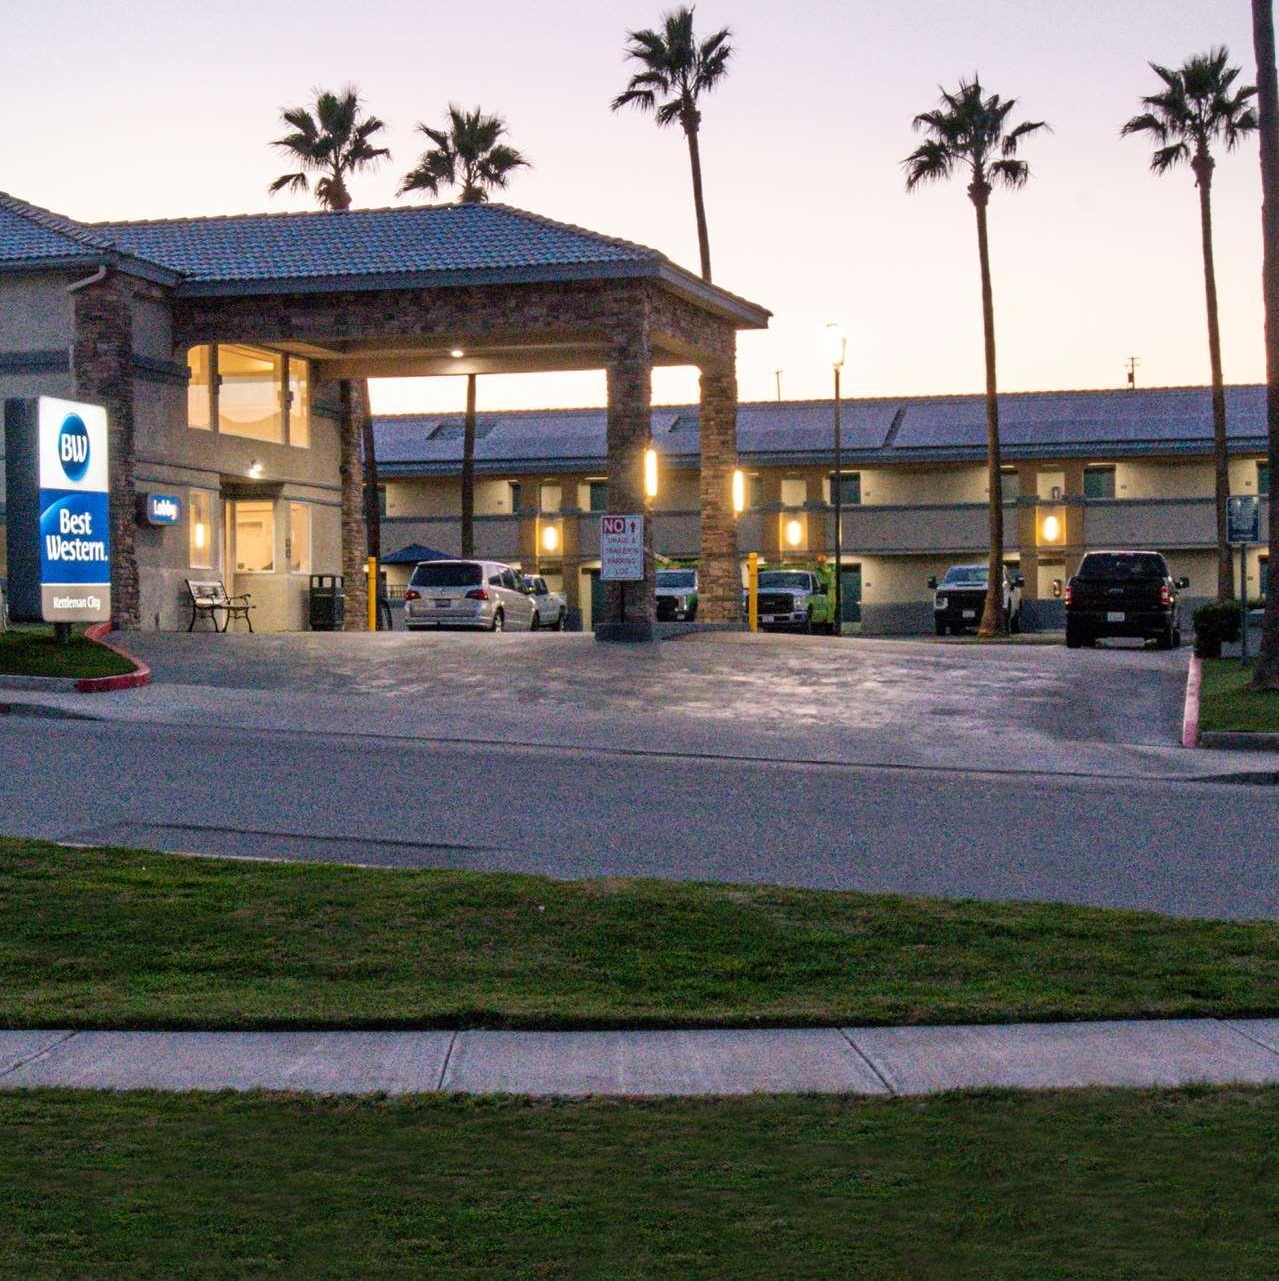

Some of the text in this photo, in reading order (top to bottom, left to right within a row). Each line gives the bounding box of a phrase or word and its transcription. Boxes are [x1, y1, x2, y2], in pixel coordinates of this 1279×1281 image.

[61, 432, 88, 463] BW
[153, 499, 177, 520] Lobby
[59, 508, 93, 536] Best
[603, 519, 625, 533] NO
